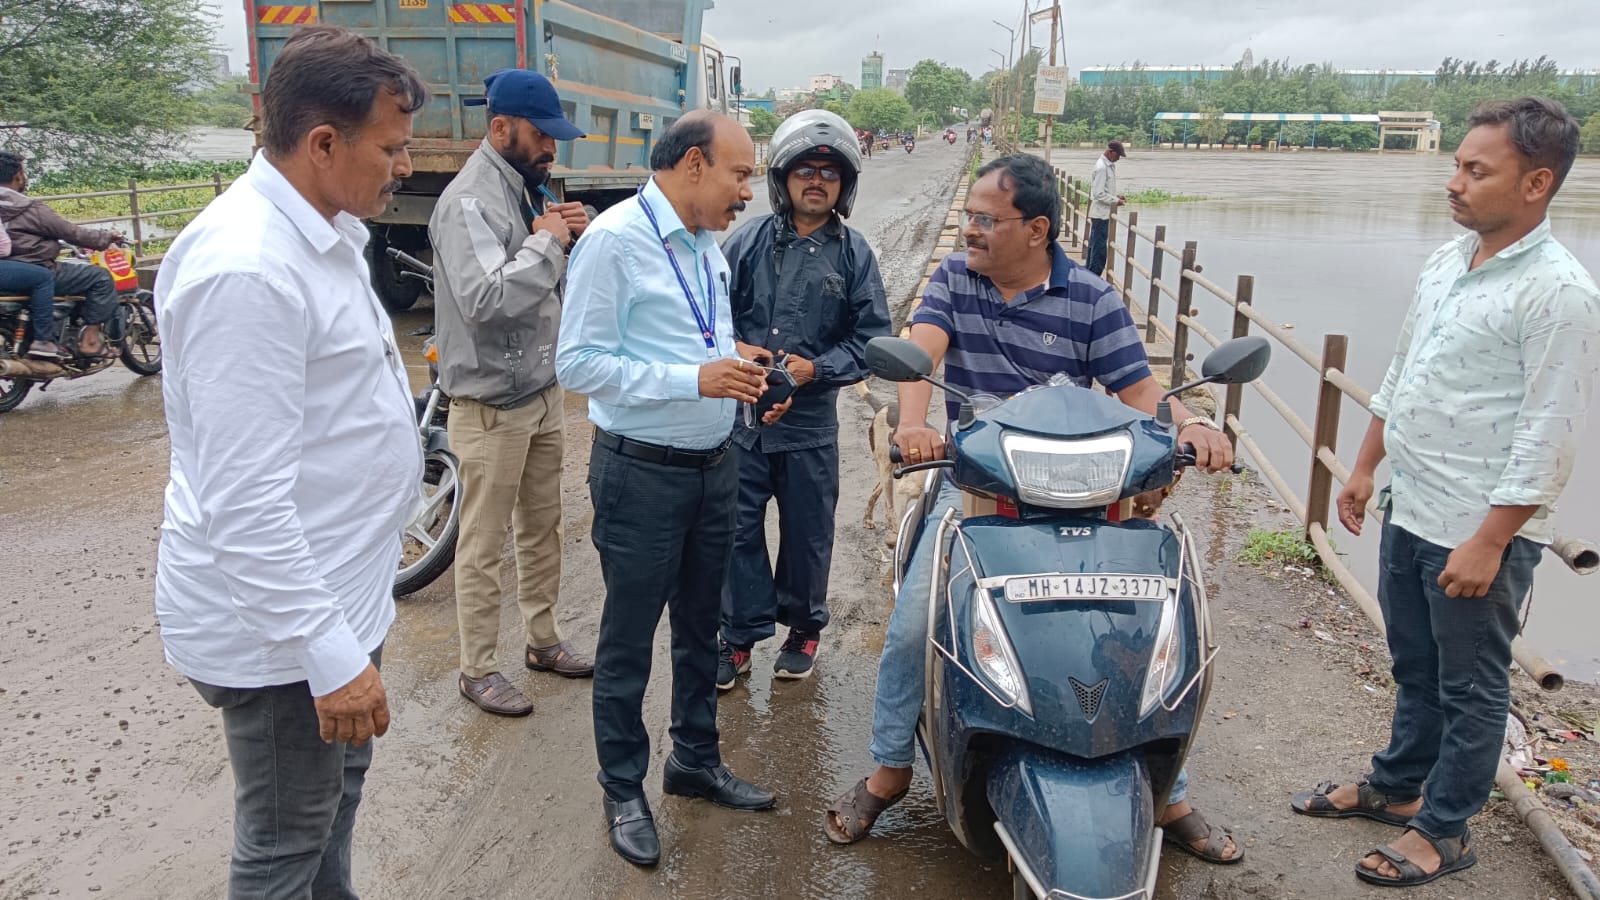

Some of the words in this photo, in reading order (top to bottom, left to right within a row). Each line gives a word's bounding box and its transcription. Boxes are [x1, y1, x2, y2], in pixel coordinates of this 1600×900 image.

[1059, 526, 1092, 537] TVS
[1028, 578, 1051, 597] MH
[1063, 577, 1109, 596] 14JZ
[1119, 578, 1163, 597] 3377
